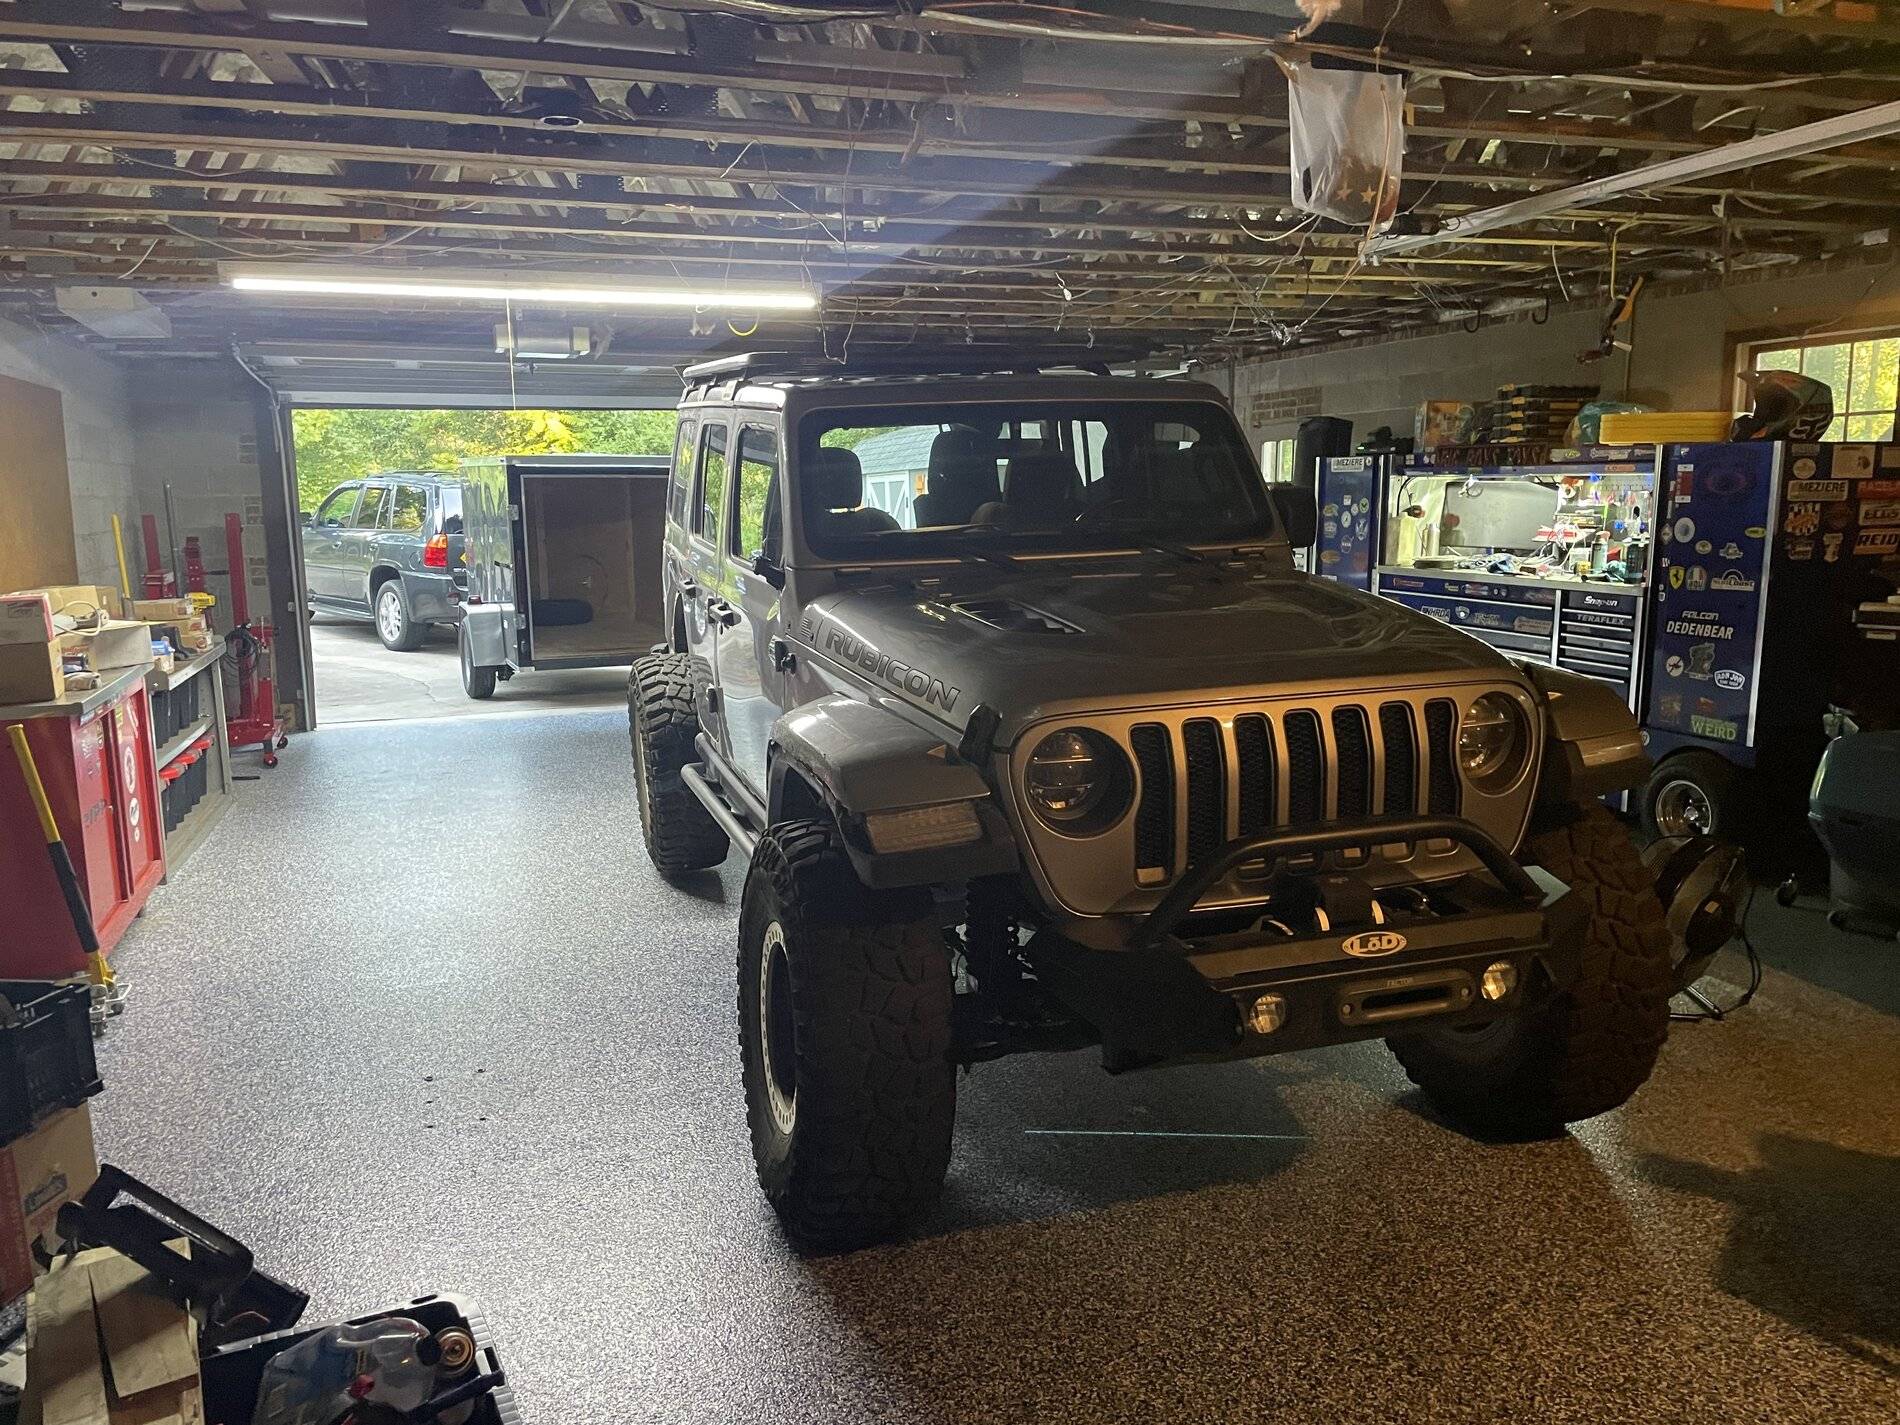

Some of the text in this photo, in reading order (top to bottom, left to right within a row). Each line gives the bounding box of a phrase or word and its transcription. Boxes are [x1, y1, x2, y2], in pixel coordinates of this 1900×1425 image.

[1799, 482, 1846, 492] MEZIERE
[1857, 534, 1898, 546] REID
[1576, 613, 1624, 625] TERAFLEX
[1666, 620, 1734, 640] DEDENBEAR
[825, 627, 962, 713] RUBICON
[1691, 719, 1736, 740] WEIRD
